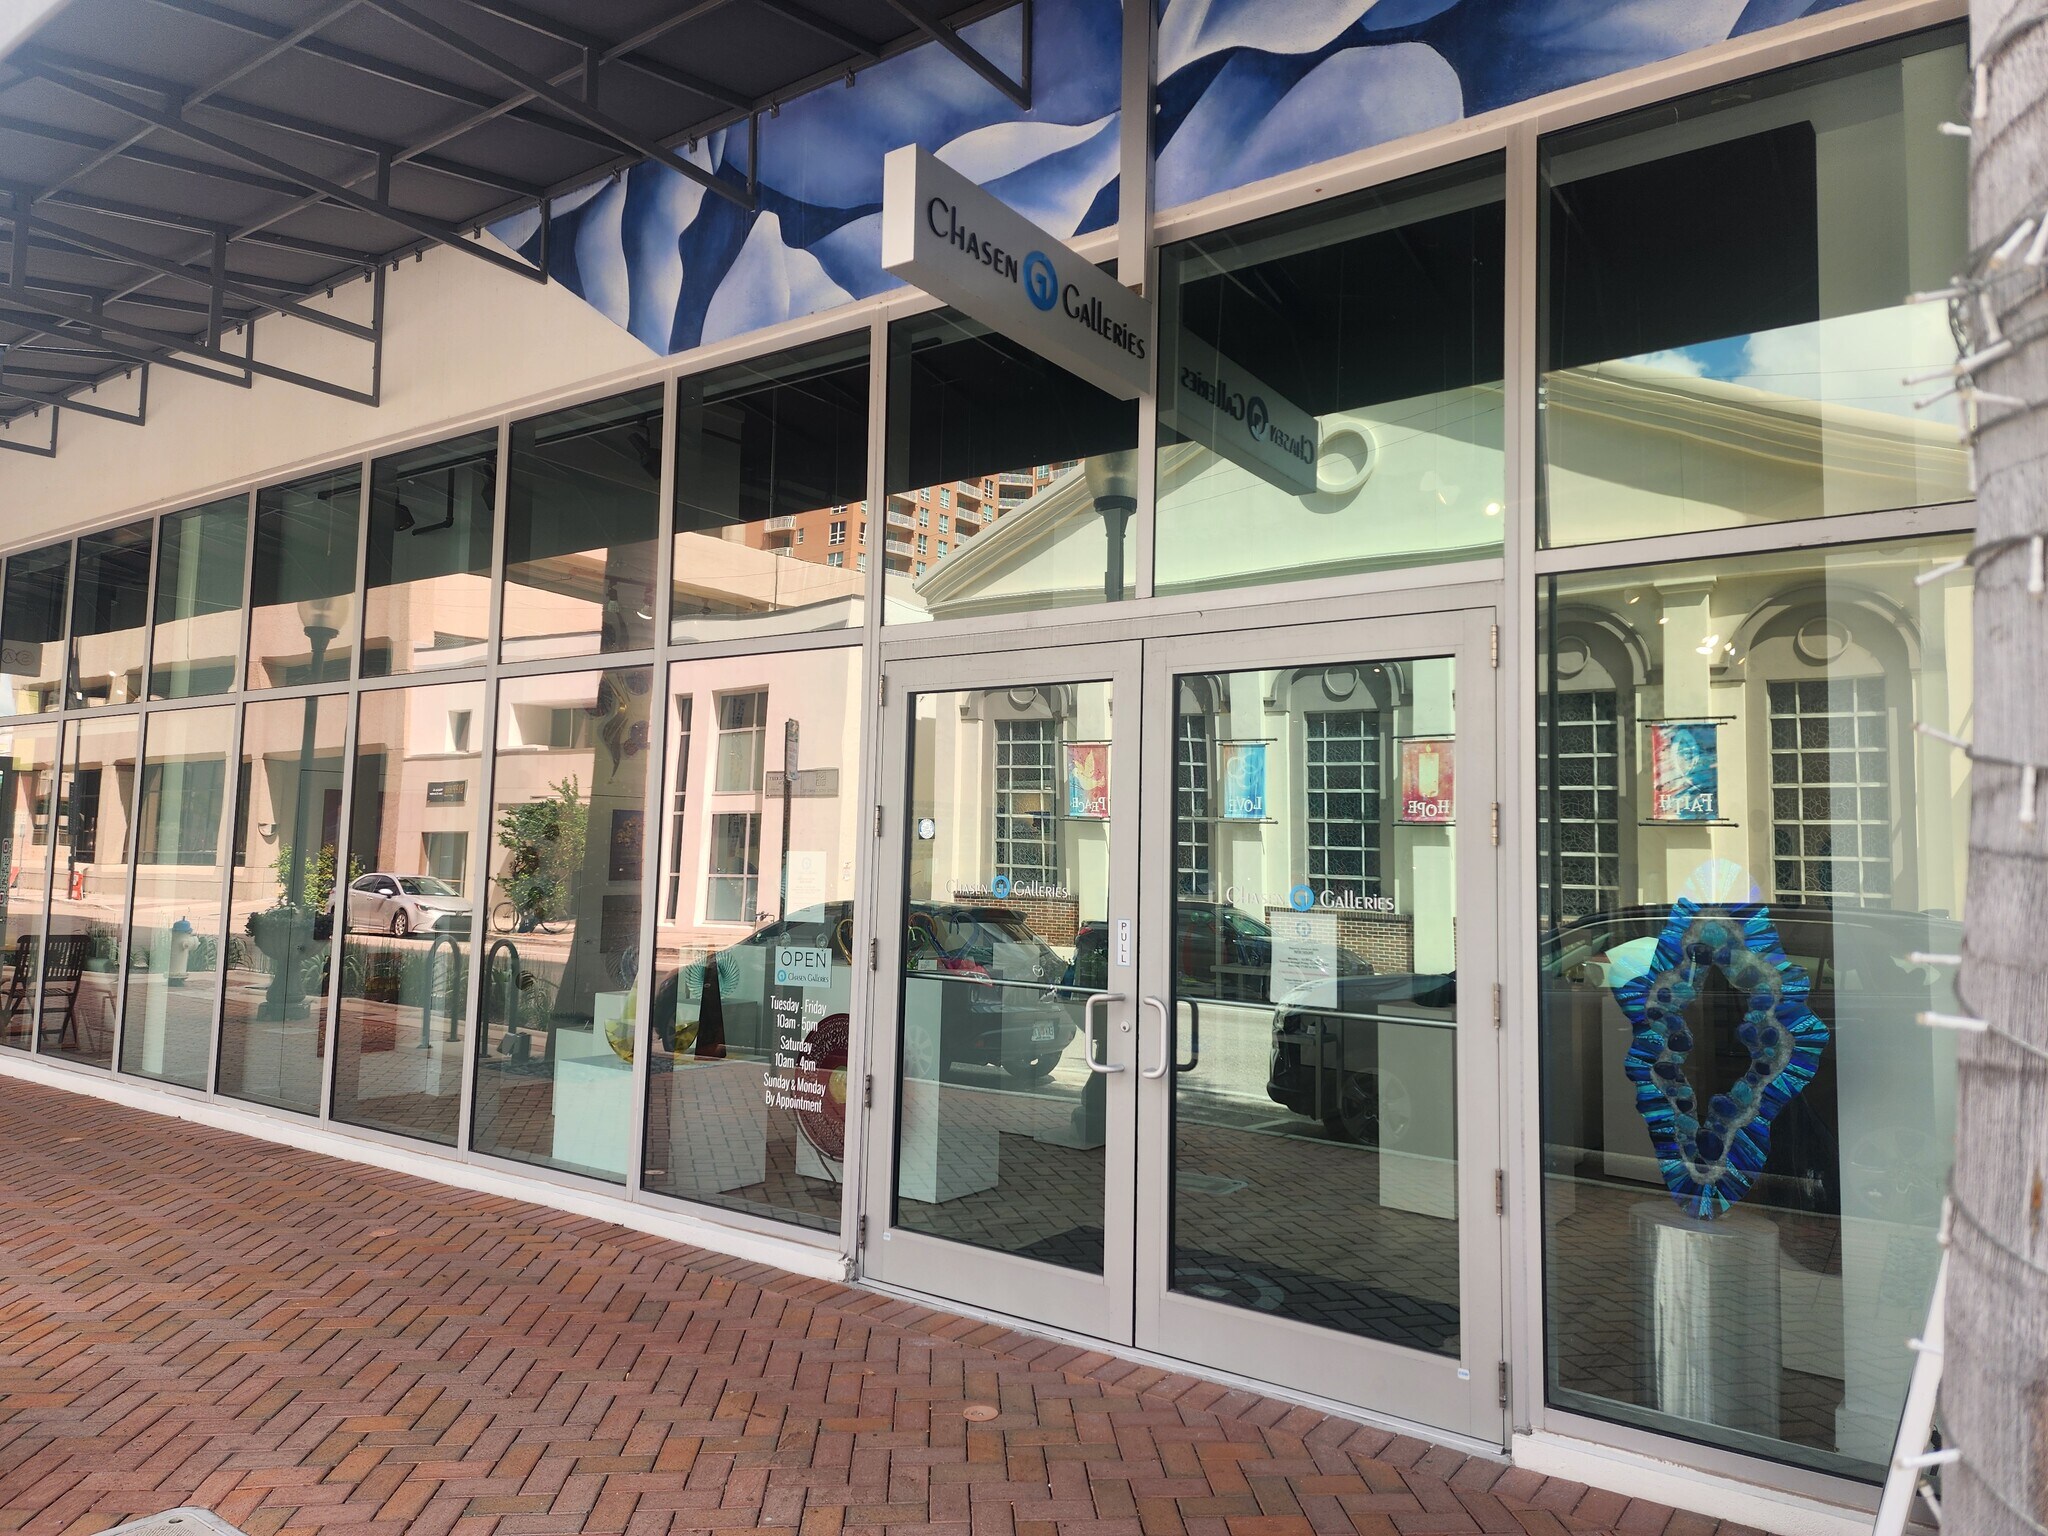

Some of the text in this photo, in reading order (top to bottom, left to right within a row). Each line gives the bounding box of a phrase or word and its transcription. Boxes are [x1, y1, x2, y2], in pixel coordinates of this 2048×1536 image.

[781, 951, 827, 968] OPEN
[770, 995, 800, 1014] Tuesday
[804, 999, 827, 1017] Friday
[777, 1013, 796, 1029] 10am
[801, 1017, 818, 1032] 5pm
[780, 1035, 812, 1055] Saturday
[775, 1052, 795, 1068] 10am
[799, 1056, 816, 1073] 4pm
[763, 1072, 791, 1092] Sunday
[796, 1077, 827, 1097] Monday
[765, 1090, 822, 1114] By Appointment
